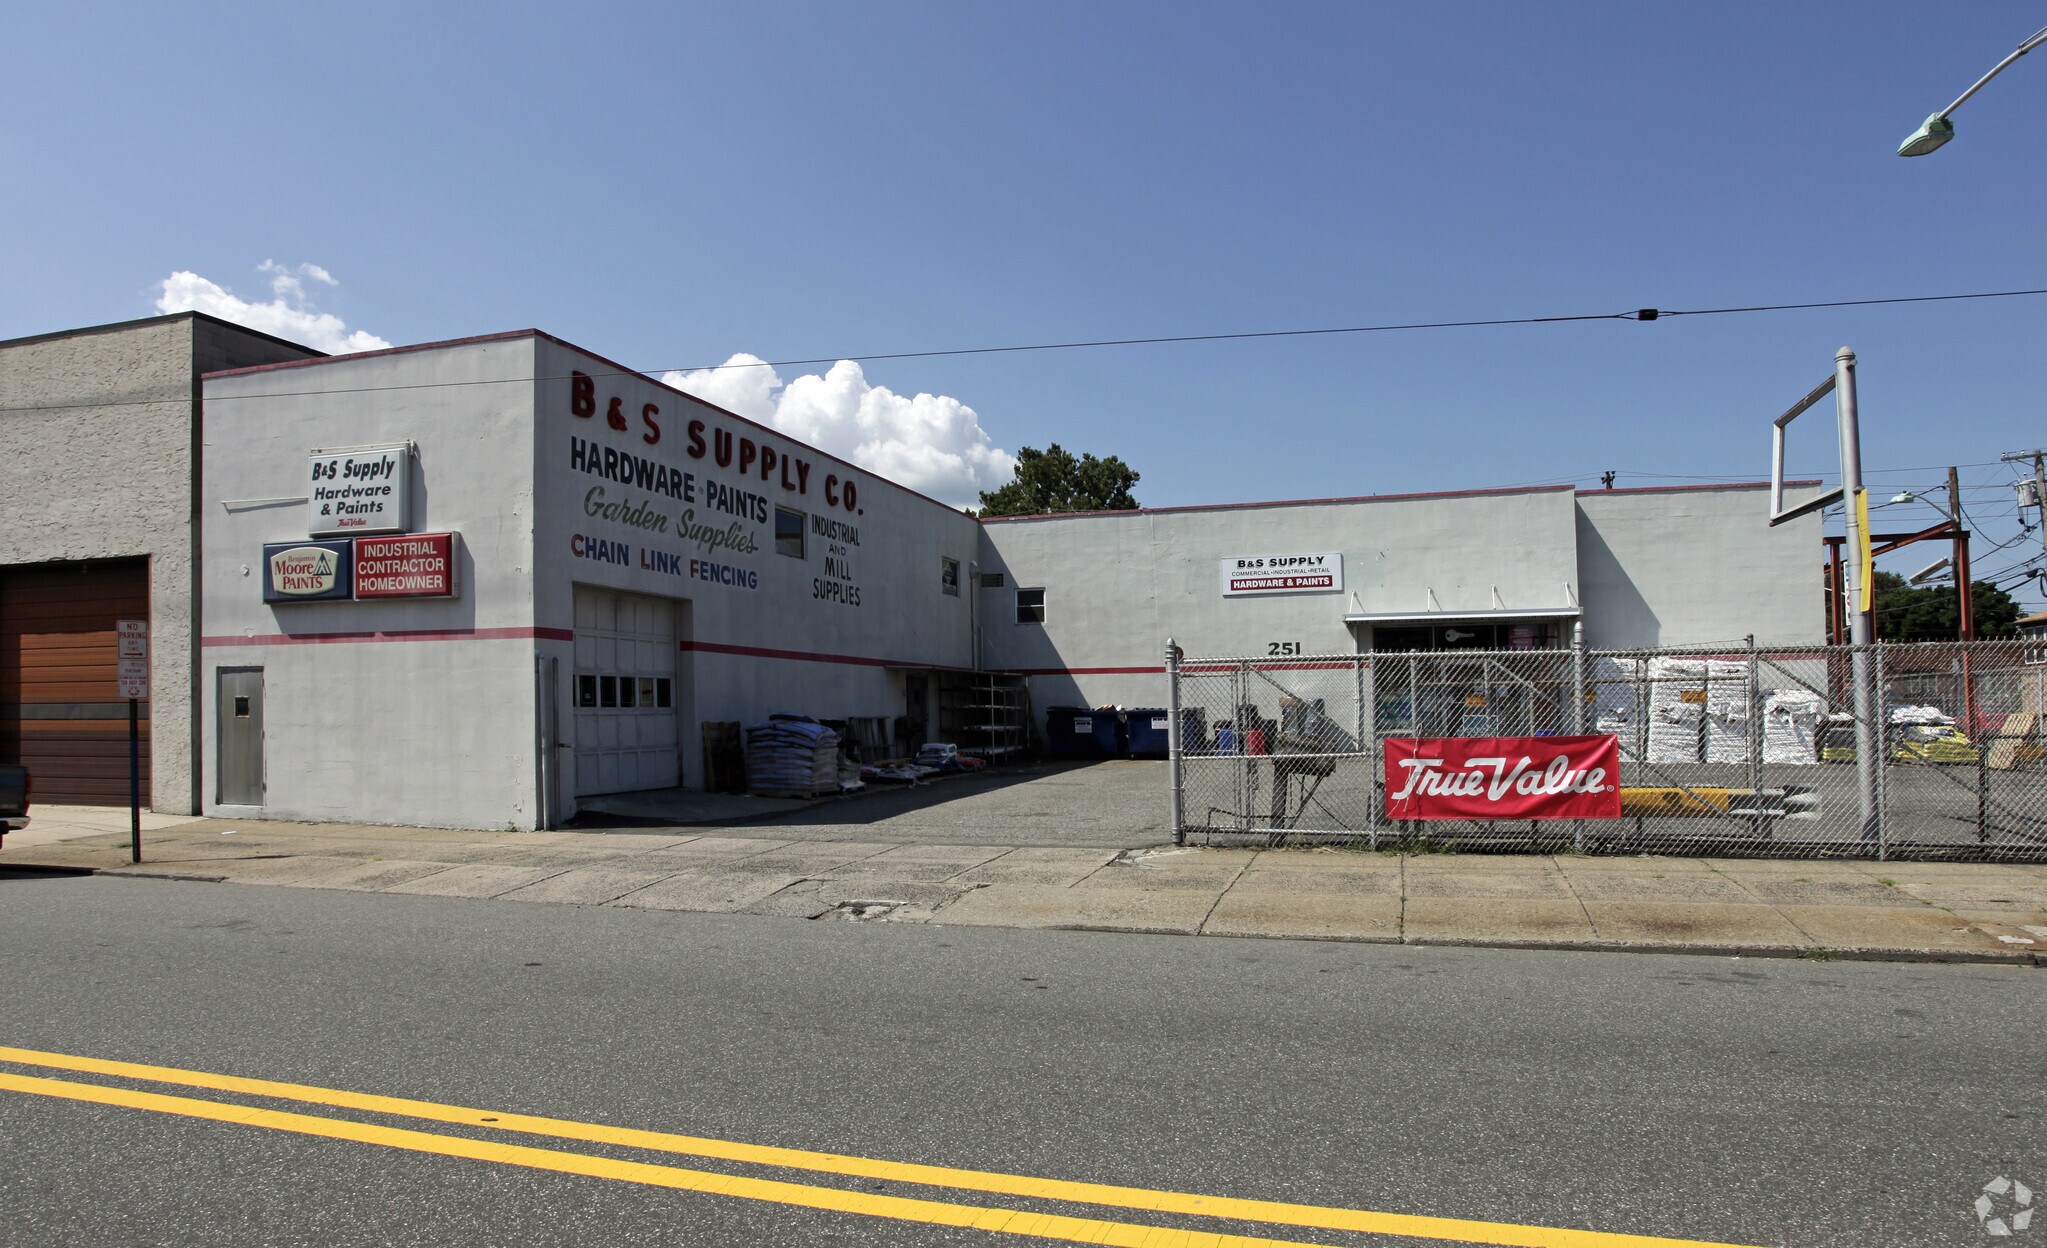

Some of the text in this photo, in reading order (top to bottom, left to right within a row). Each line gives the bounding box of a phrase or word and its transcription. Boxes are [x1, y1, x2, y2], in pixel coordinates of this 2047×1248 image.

[572, 370, 863, 516] B & S SUPPLY CO.
[312, 455, 395, 481] B&S Supply
[571, 436, 768, 524] HARDWARE PAINTS
[315, 484, 391, 500] Hardware
[321, 500, 383, 516] & Paints
[583, 485, 760, 555] Garden Supplies
[811, 513, 860, 547] INDUSTRIAL
[364, 542, 437, 558] INDUSTRIAL
[829, 544, 846, 556] AND
[288, 555, 316, 564] Benjamin
[358, 558, 444, 575] CONTRACTOR
[571, 533, 758, 589] CHAIN LINK FENCING
[1237, 556, 1325, 569] B&S SUPPLY
[274, 561, 314, 576] Moore
[825, 556, 852, 581] MILL
[282, 576, 323, 590] PAINTS
[359, 575, 443, 591] HOMEOWNER
[1233, 577, 1330, 589] HARDWARE & PAINTS
[813, 578, 860, 607] SUPPLIES
[127, 623, 138, 631] NO
[119, 632, 146, 640] PARKING
[1268, 642, 1300, 656] 251
